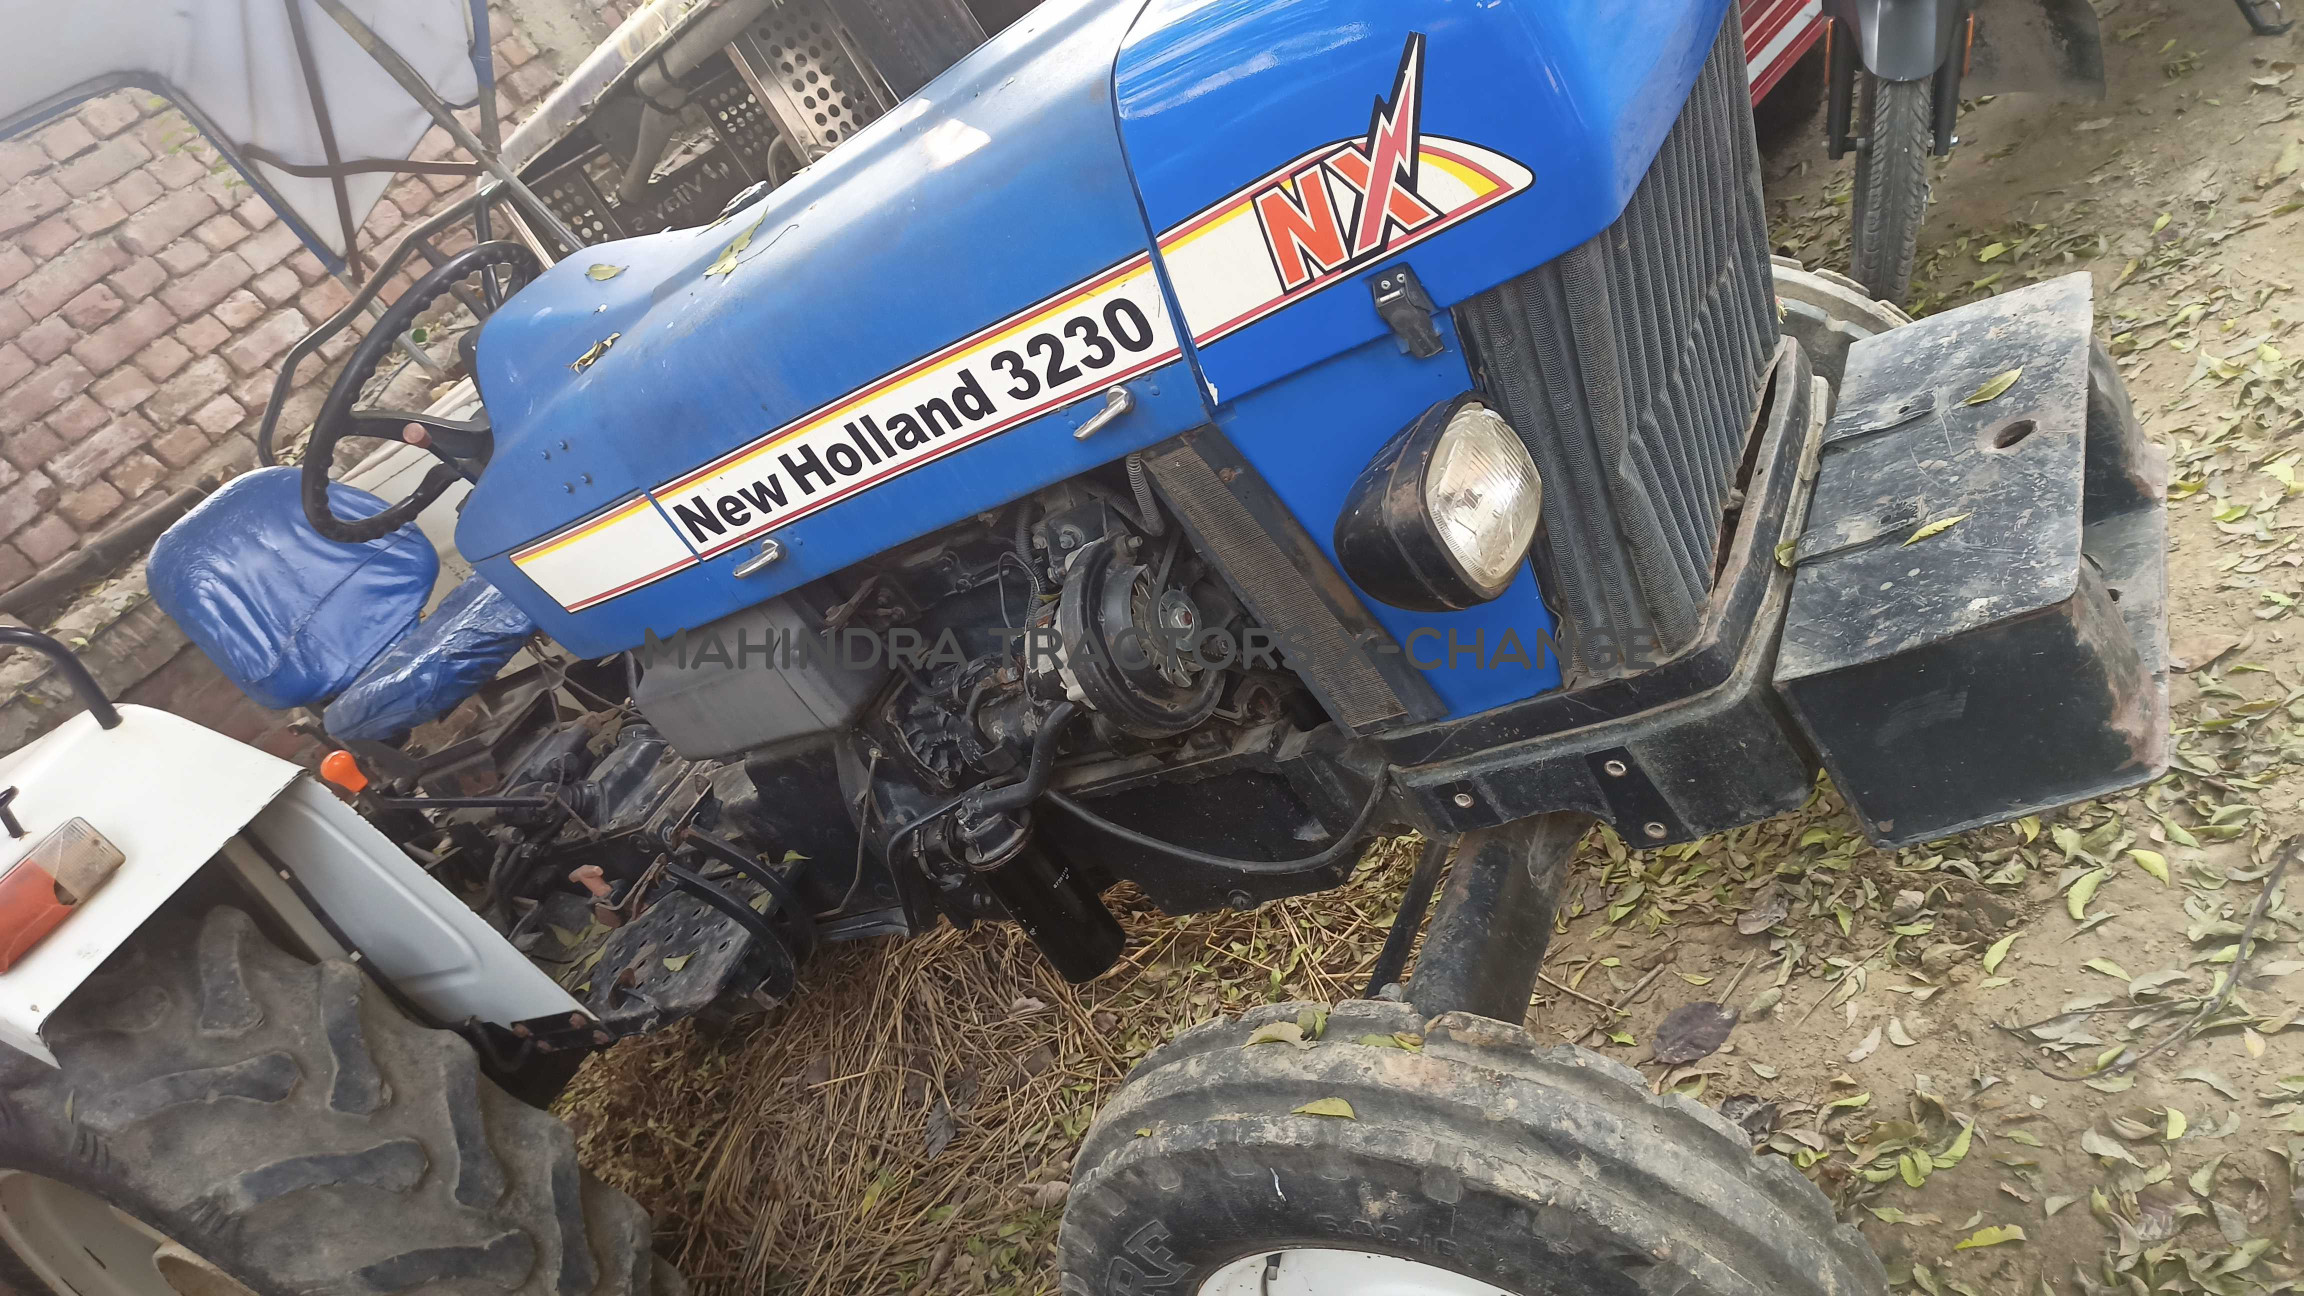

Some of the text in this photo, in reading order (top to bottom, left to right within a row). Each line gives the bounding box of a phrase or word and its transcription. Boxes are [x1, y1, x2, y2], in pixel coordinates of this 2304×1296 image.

[1251, 31, 1446, 295] NX
[672, 297, 1154, 543] New Holland 3230
